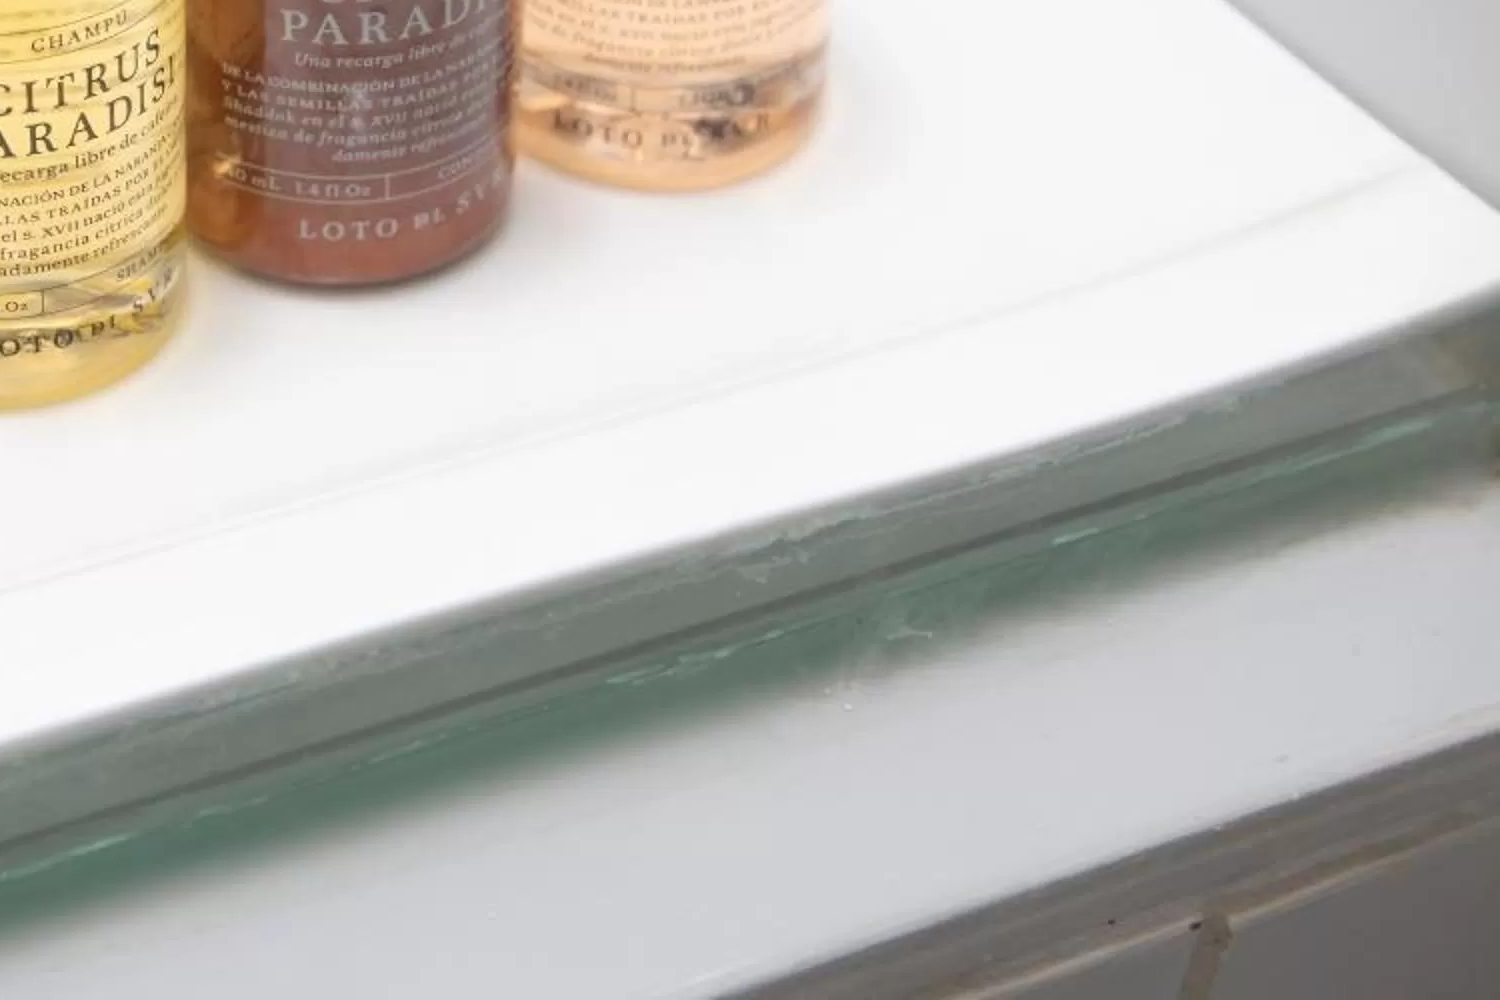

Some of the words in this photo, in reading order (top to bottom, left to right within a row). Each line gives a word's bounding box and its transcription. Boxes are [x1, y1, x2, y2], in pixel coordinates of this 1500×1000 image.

[295, 53, 331, 68] Una
[336, 53, 404, 69] recarga
[75, 144, 116, 169] libre
[120, 133, 138, 150] de
[69, 181, 90, 197] DE
[93, 173, 112, 189] LA
[1, 229, 17, 242] el
[42, 219, 80, 240] XVII
[298, 217, 399, 241] LOTO
[0, 235, 89, 261] fragancia
